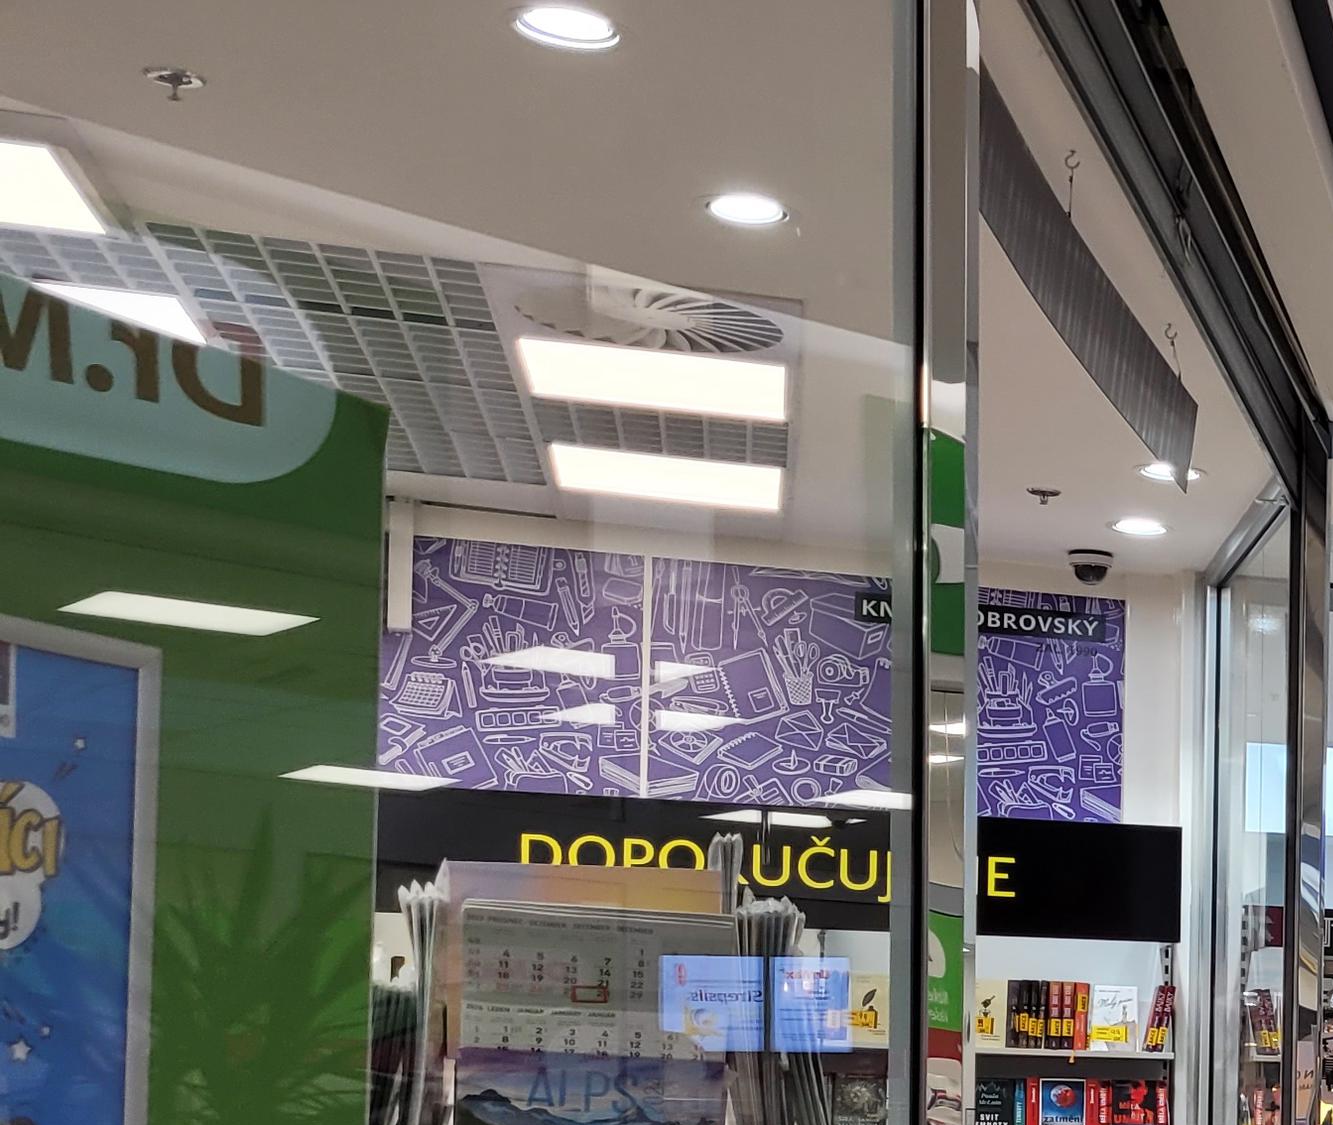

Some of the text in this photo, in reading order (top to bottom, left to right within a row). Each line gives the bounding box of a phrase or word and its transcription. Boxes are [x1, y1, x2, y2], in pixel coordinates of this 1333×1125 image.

[532, 963, 544, 972] 12
[599, 968, 612, 978] 14
[532, 974, 544, 983] 19
[563, 976, 578, 985] 20
[979, 1113, 999, 1122] SVIT
